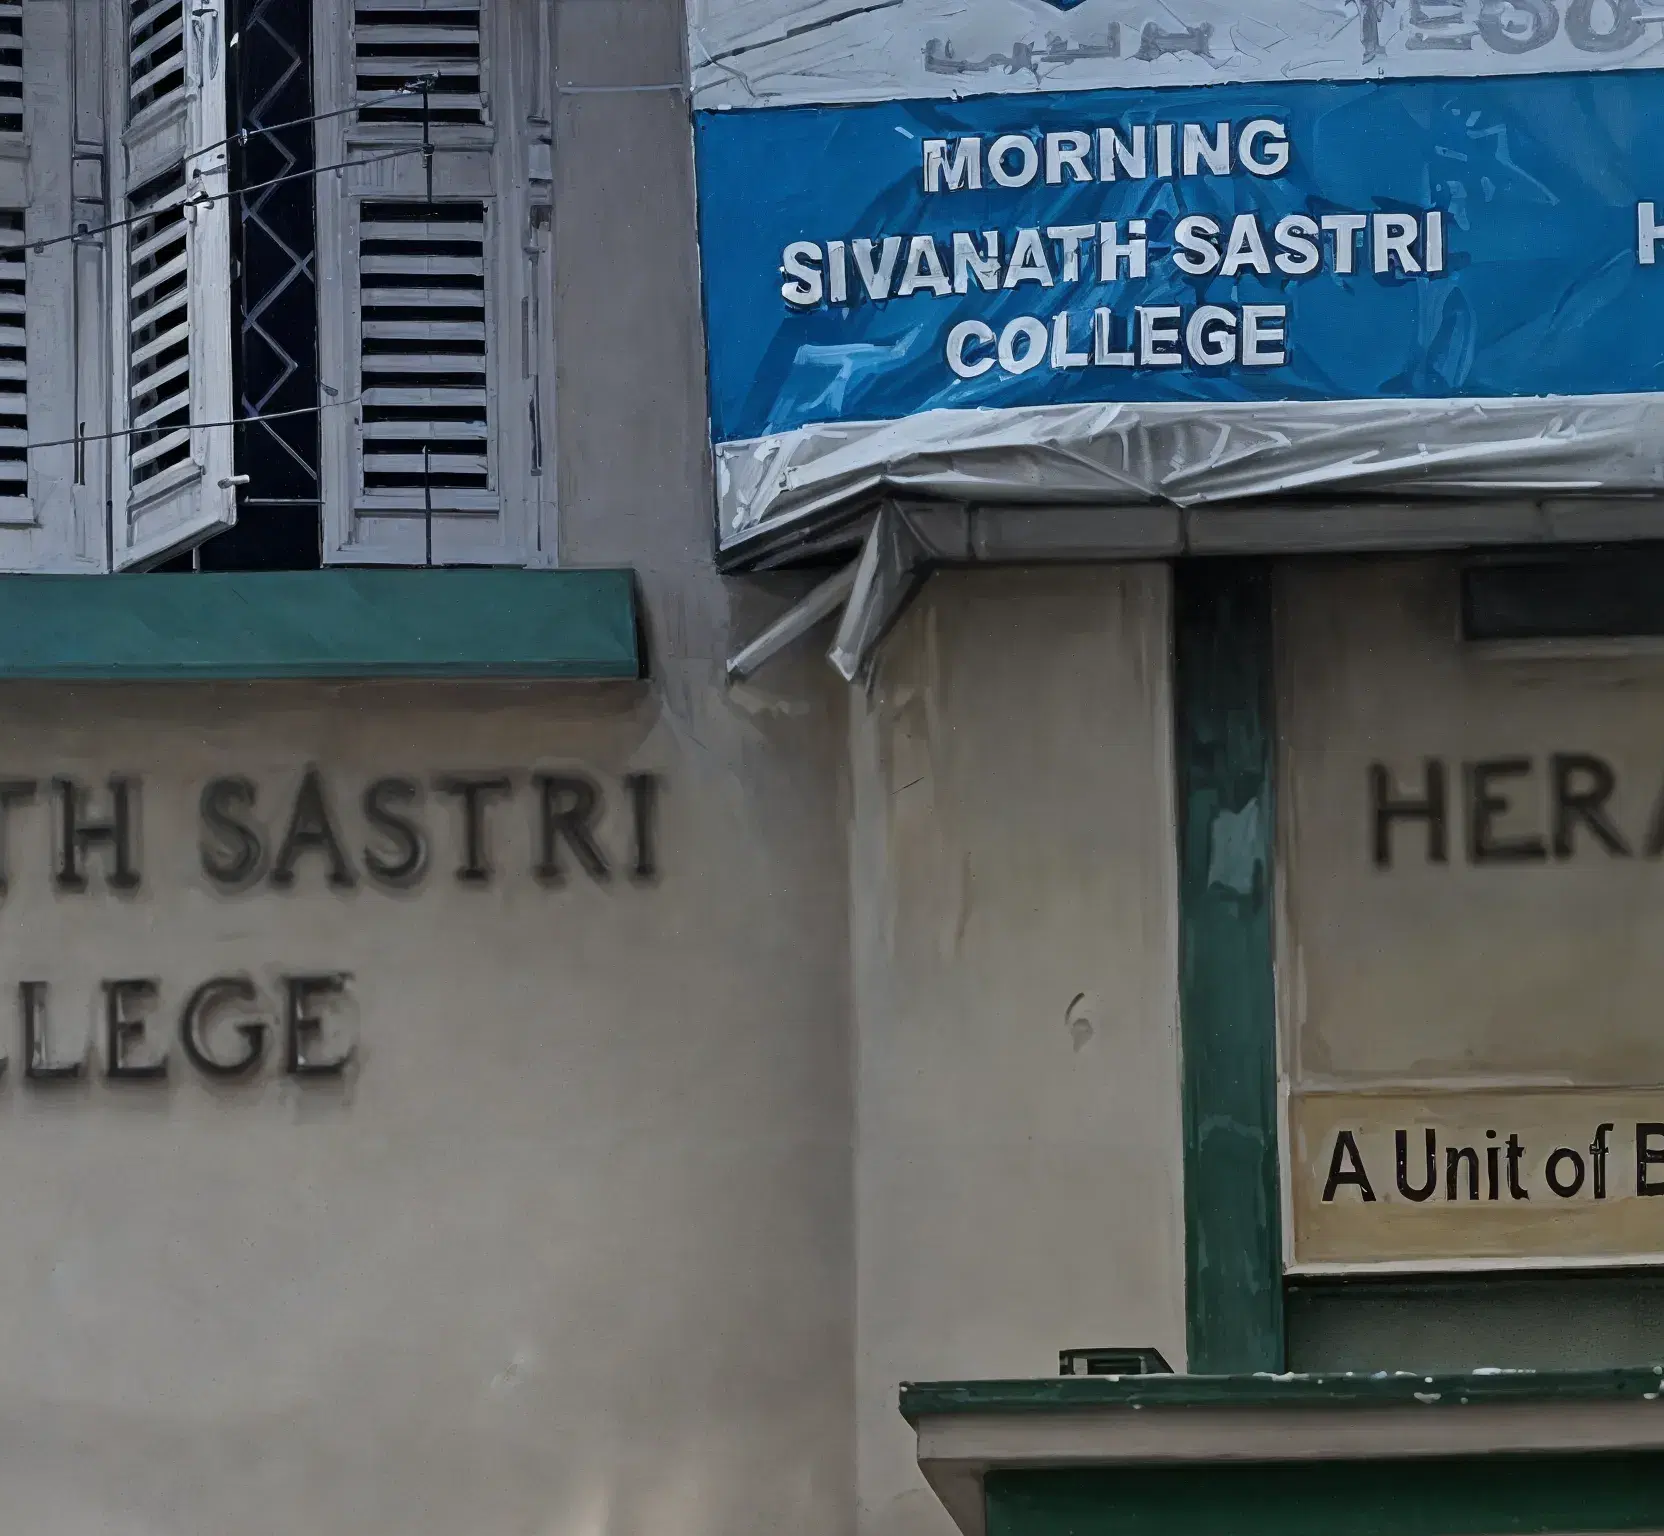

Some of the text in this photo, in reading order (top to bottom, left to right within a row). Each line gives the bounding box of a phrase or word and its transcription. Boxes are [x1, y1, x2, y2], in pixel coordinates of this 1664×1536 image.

[923, 118, 1291, 194] MORNING
[780, 208, 1444, 310] SIVANATH SASTRI
[946, 303, 1286, 380] COLLEGE
[198, 764, 666, 890] SASTRI
[1322, 1131, 1376, 1201] A
[1396, 1129, 1528, 1201] Unit
[1544, 1123, 1614, 1199] of
